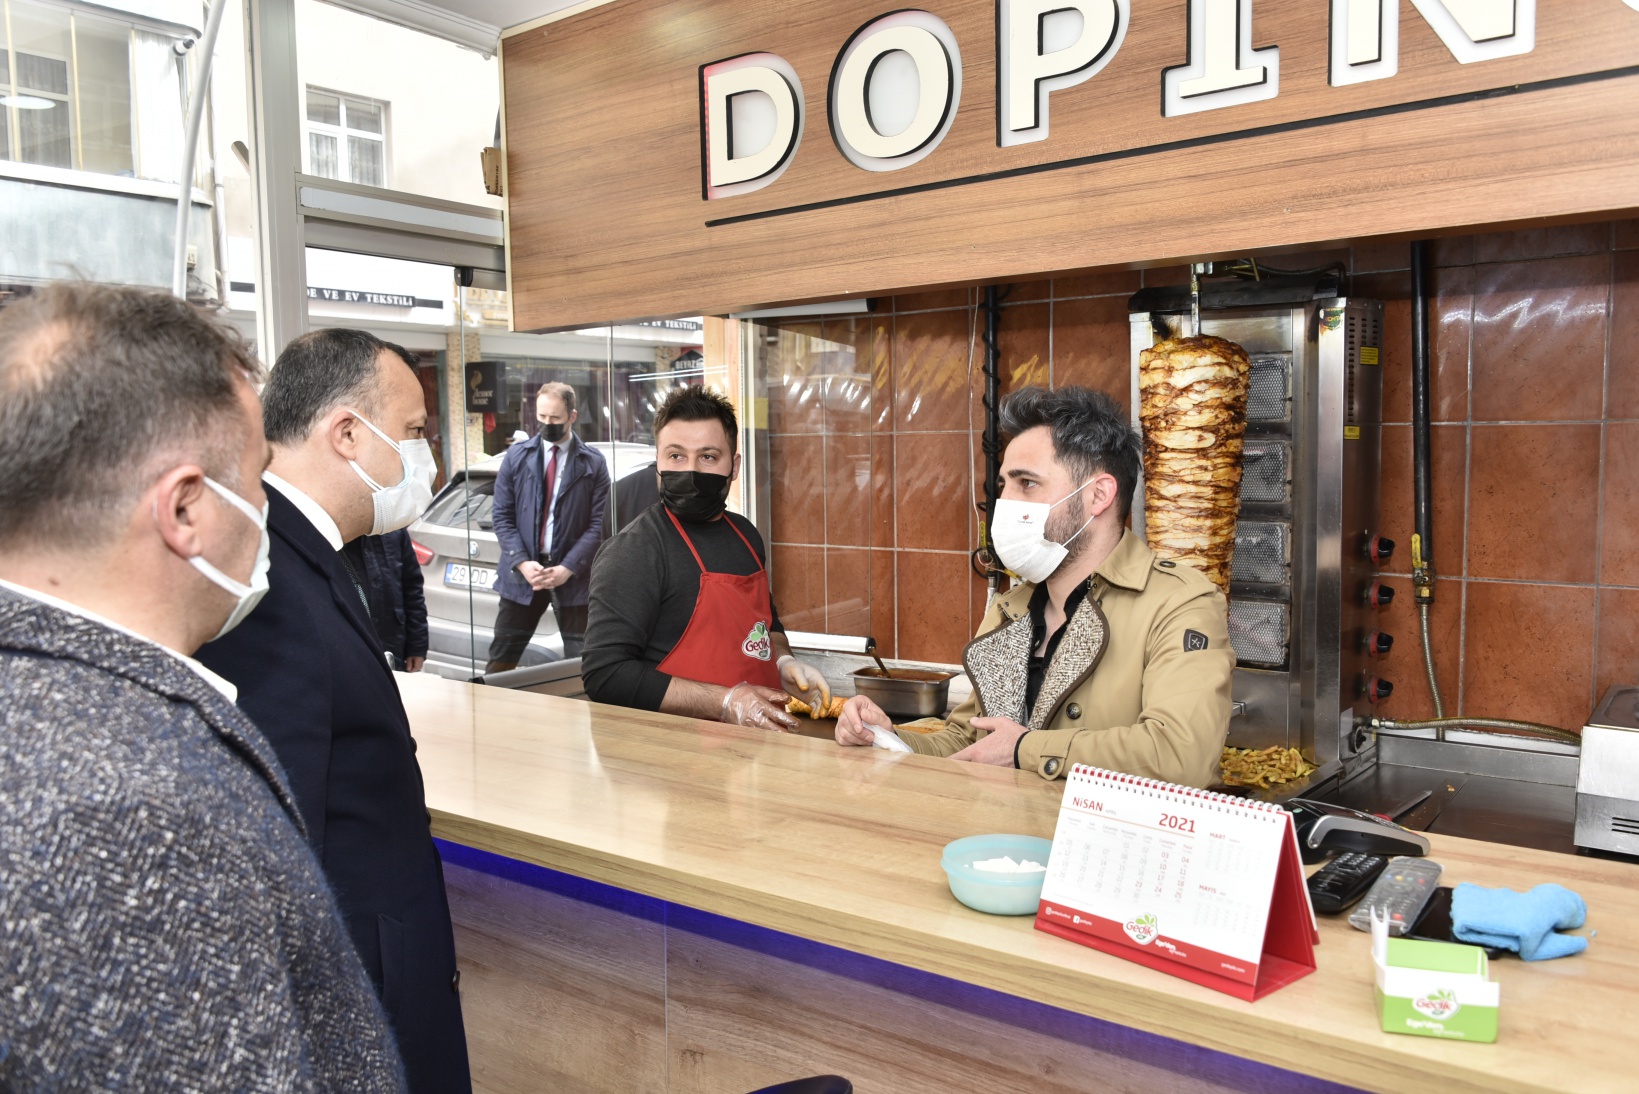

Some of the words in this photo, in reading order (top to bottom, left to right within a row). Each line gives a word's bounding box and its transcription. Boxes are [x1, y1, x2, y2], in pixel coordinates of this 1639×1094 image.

[323, 290, 339, 299] VE
[345, 291, 360, 301] EV
[452, 566, 466, 582] 29
[1158, 813, 1196, 833] 2021
[1125, 921, 1154, 936] Gedik
[1416, 998, 1451, 1011] Gedik
